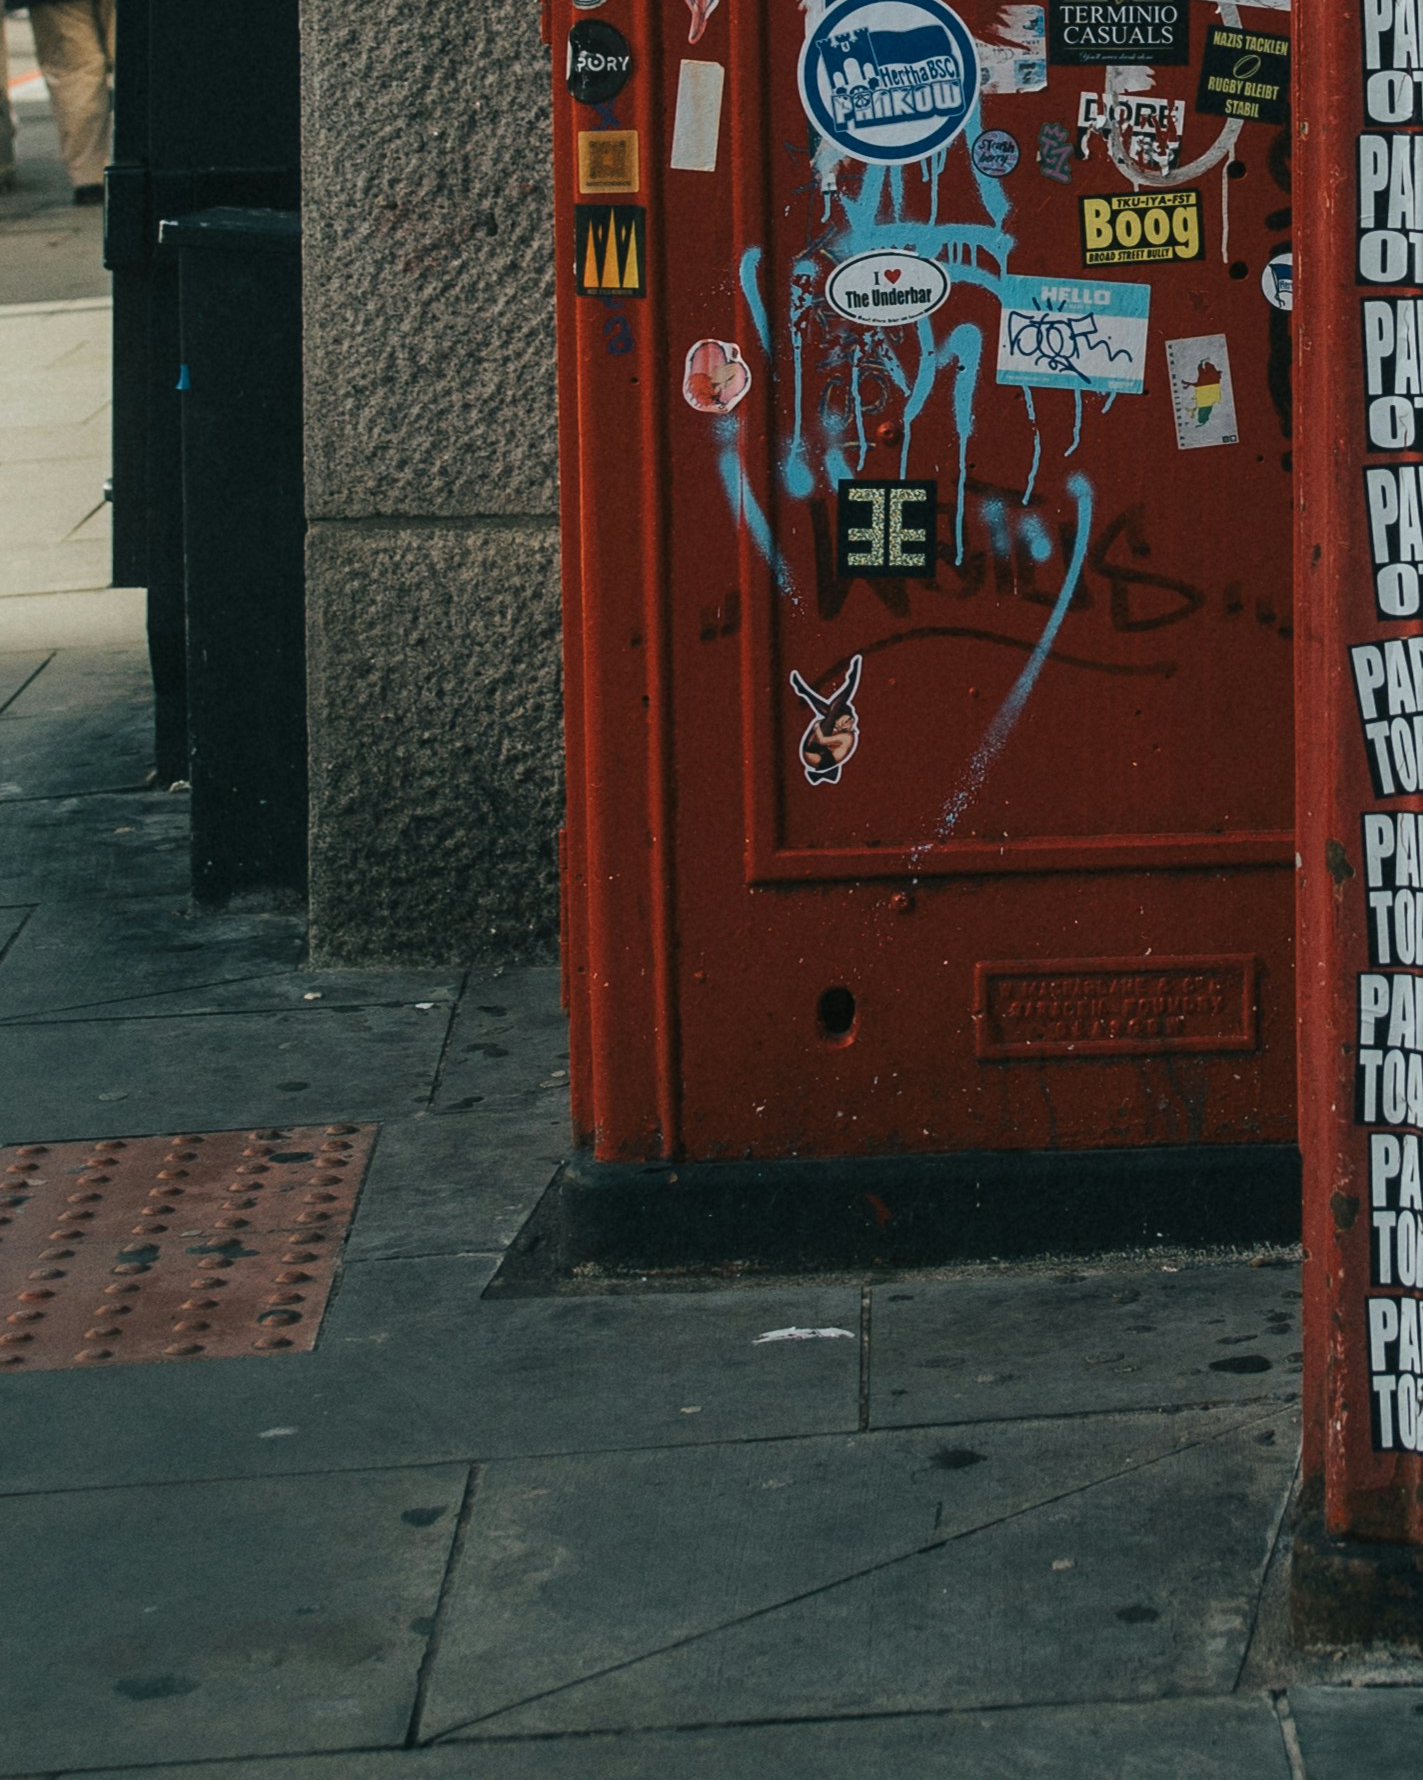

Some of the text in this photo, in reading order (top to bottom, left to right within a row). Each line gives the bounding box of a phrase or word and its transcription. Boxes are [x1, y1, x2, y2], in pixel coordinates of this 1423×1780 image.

[1060, 5, 1176, 24] TERMINIO
[1063, 26, 1174, 44] CASUALS
[1213, 31, 1288, 56] NAZIS TACKLEN
[880, 57, 955, 88] Hertha BSC
[1208, 76, 1280, 100] RUGBY BLEIBT
[1225, 99, 1259, 118] STABIL
[1083, 198, 1199, 258] Boog
[1088, 247, 1170, 262] BROAD STREET BULLY
[845, 289, 932, 308] The Underbar
[1041, 286, 1110, 305] HELLO
